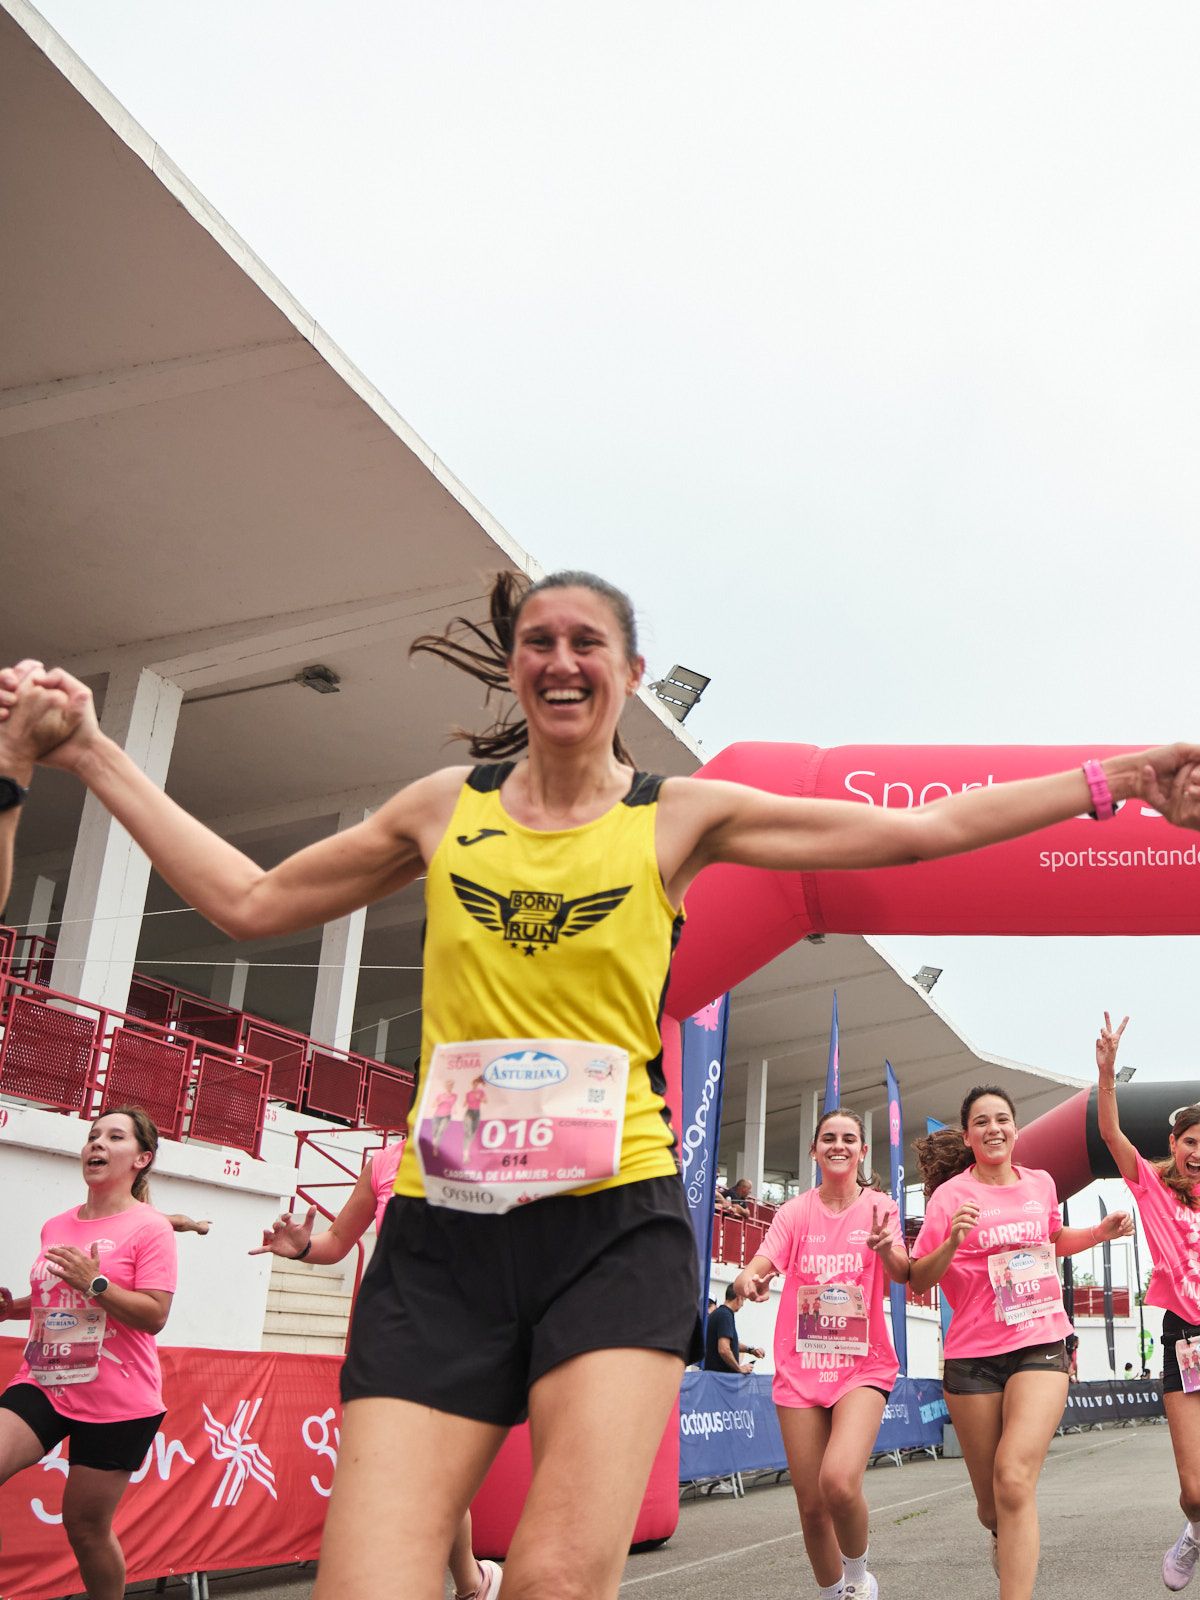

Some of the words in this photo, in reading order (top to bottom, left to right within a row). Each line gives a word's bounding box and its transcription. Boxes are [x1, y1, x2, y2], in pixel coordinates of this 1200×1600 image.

[513, 894, 559, 911] BORN
[509, 922, 556, 941] RUN
[491, 1066, 561, 1080] ASTURIANA
[481, 1118, 554, 1150] 016
[502, 1153, 528, 1168] 614
[485, 1169, 500, 1181] DE
[501, 1170, 514, 1181] LA
[442, 1185, 494, 1205] OYSHO
[978, 1220, 1043, 1249] CARRERA
[800, 1252, 864, 1275] CARRERA
[1014, 1279, 1041, 1295] 016
[820, 1315, 847, 1329] 016
[42, 1342, 72, 1357] 016
[801, 1351, 855, 1370] MUJER
[818, 1370, 839, 1383] 2026
[1074, 1394, 1113, 1408] VOLVO
[1116, 1391, 1159, 1405] VOLVO
[680, 1410, 724, 1440] octopus
[723, 1409, 755, 1439] energy
